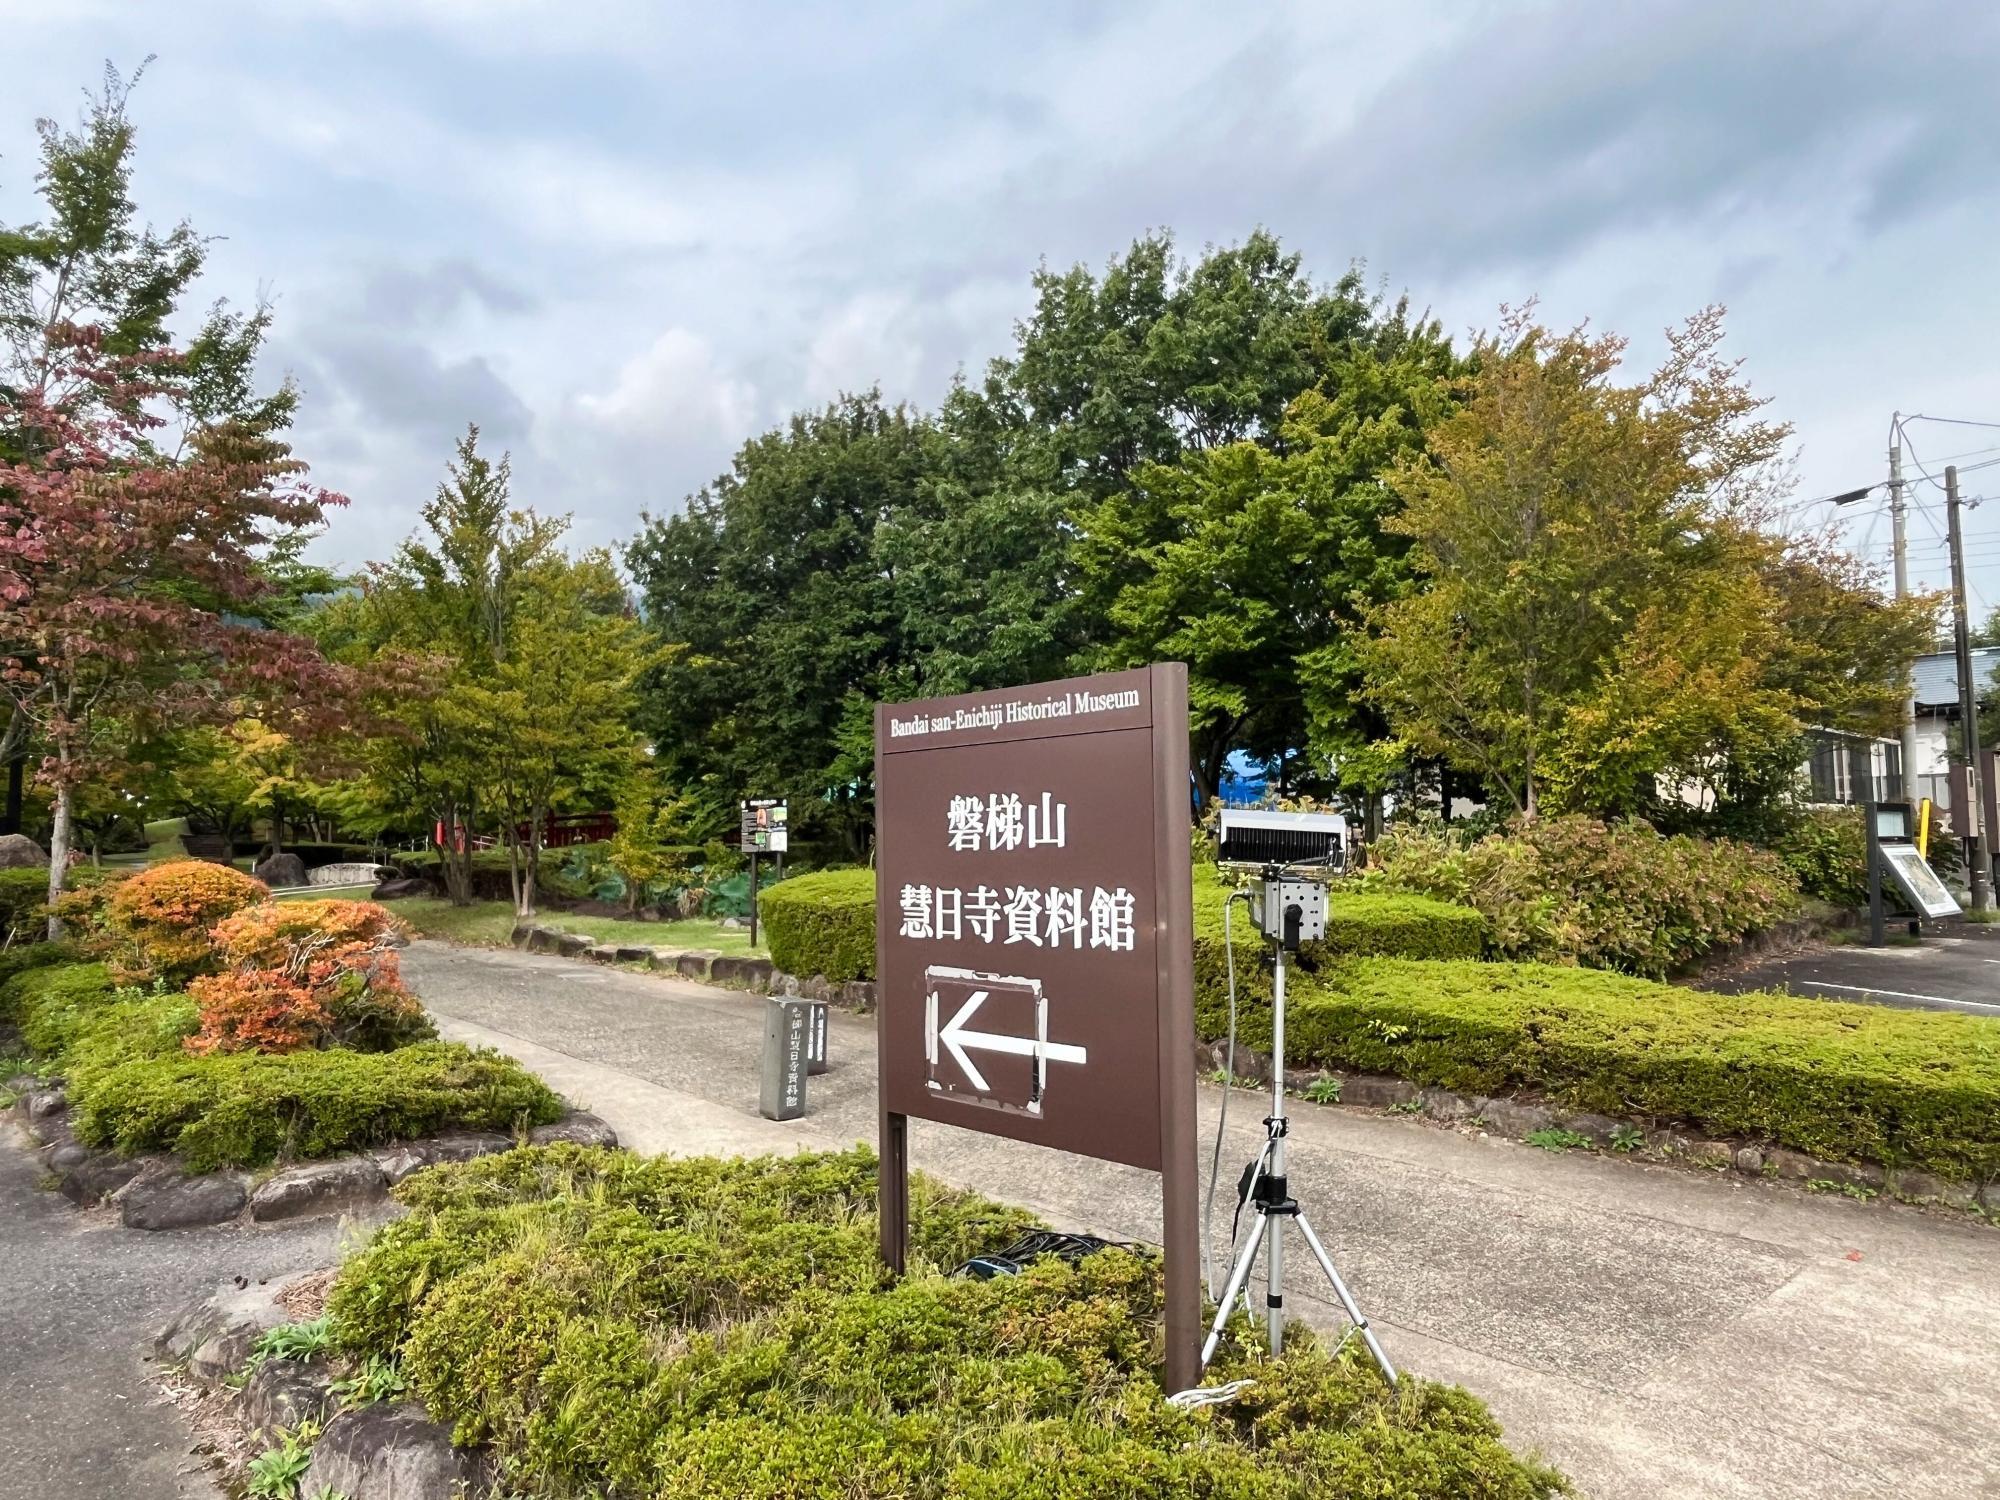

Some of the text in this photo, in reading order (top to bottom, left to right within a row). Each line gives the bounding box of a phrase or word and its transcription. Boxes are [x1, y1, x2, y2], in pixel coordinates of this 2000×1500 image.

[891, 690, 1139, 737] Bandai san-Enichiji Historical Museum
[947, 792, 1066, 851] 磐梯山
[900, 884, 1135, 951] 慧日寺資料館
